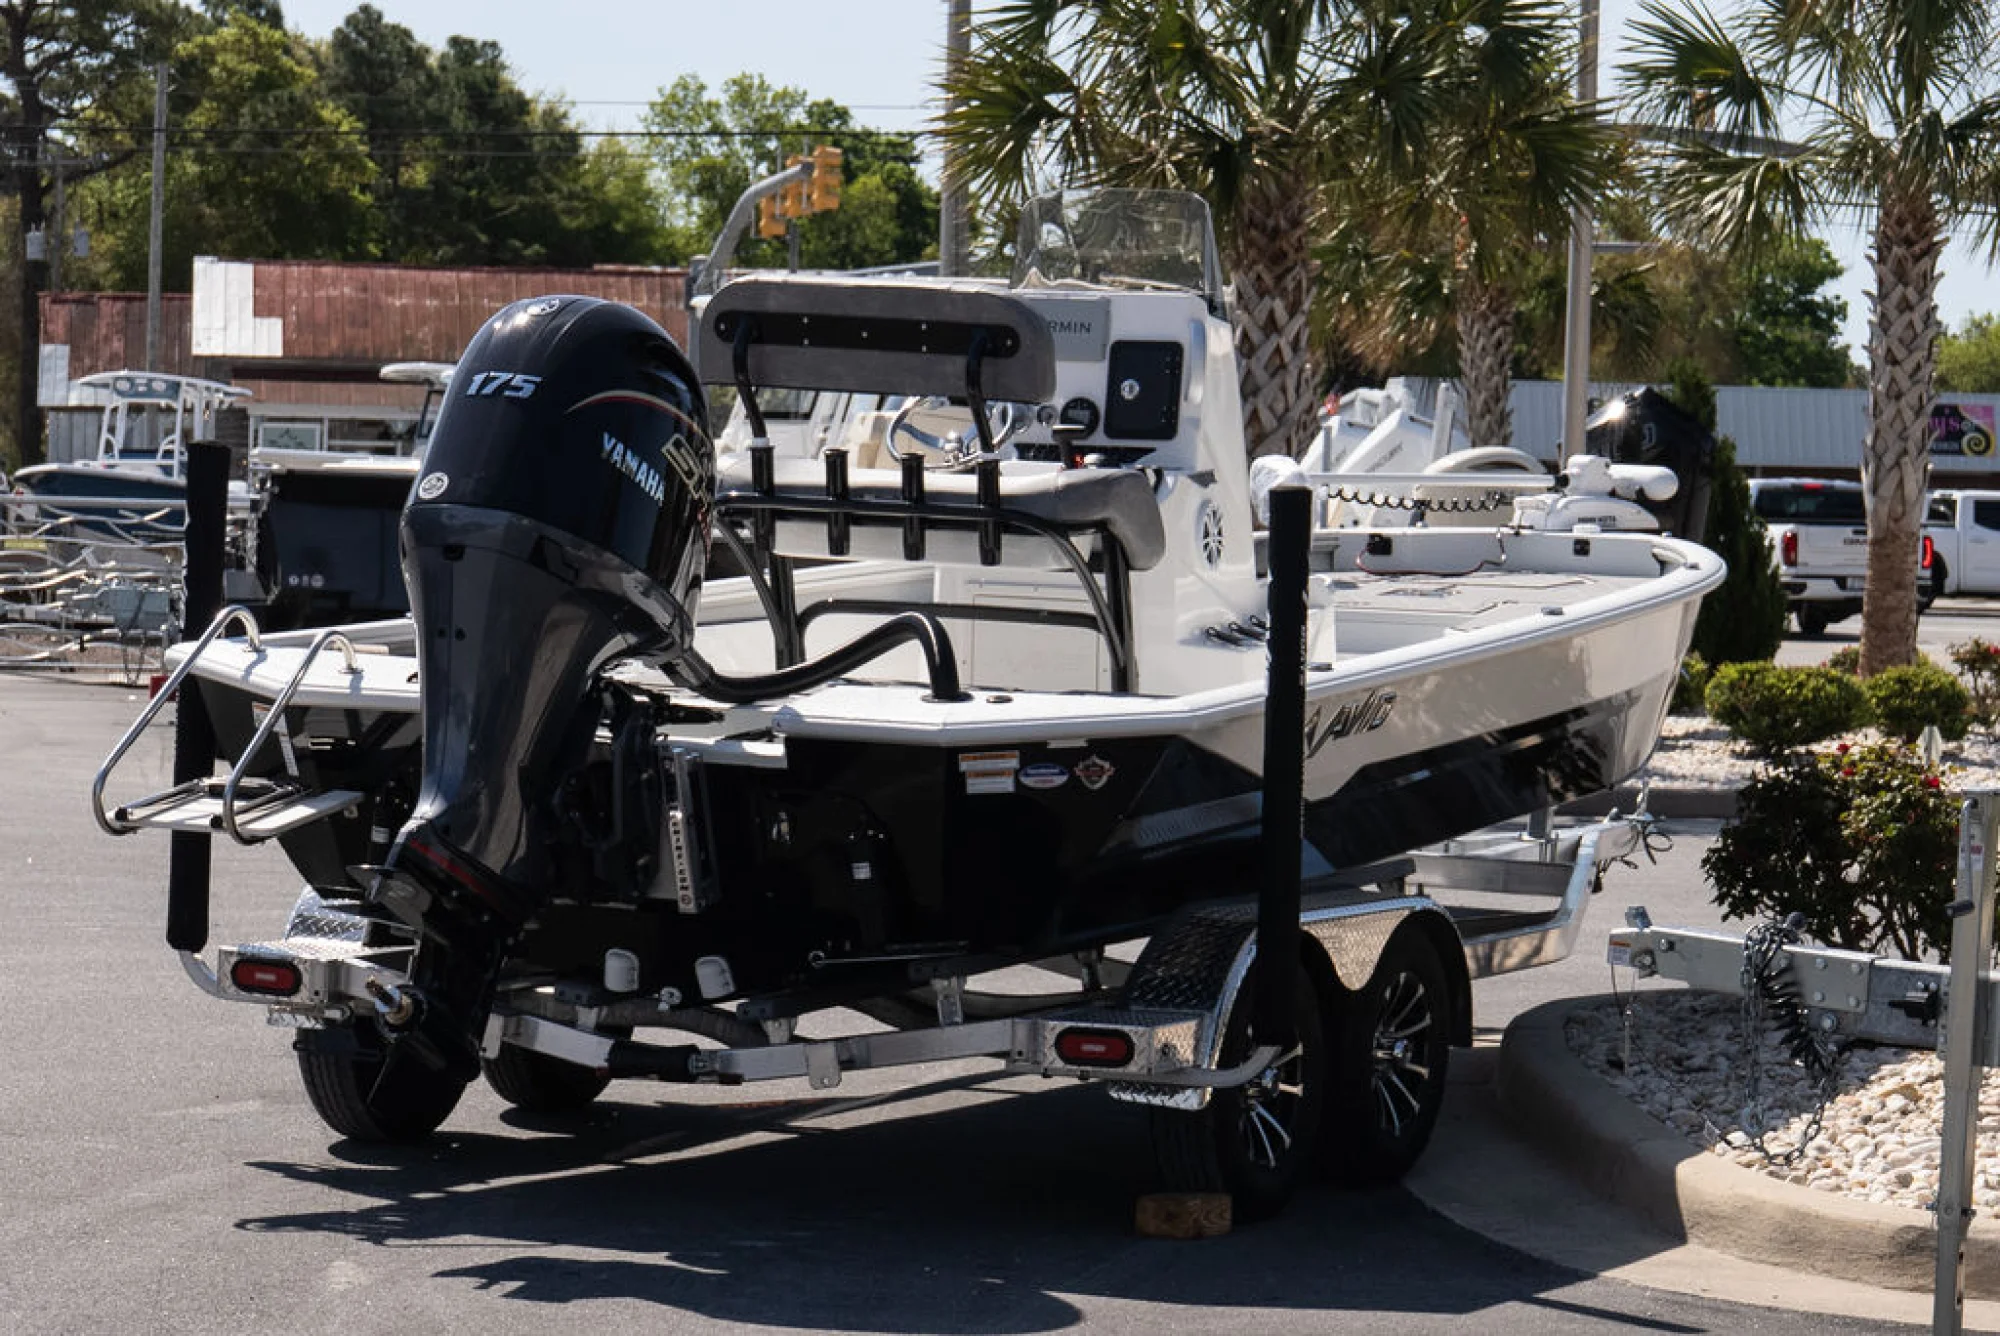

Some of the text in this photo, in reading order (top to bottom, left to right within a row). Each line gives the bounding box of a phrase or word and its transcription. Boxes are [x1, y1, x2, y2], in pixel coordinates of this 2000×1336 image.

[1048, 320, 1092, 335] RMIN
[466, 371, 542, 399] 175
[602, 431, 665, 507] YAMAHA
